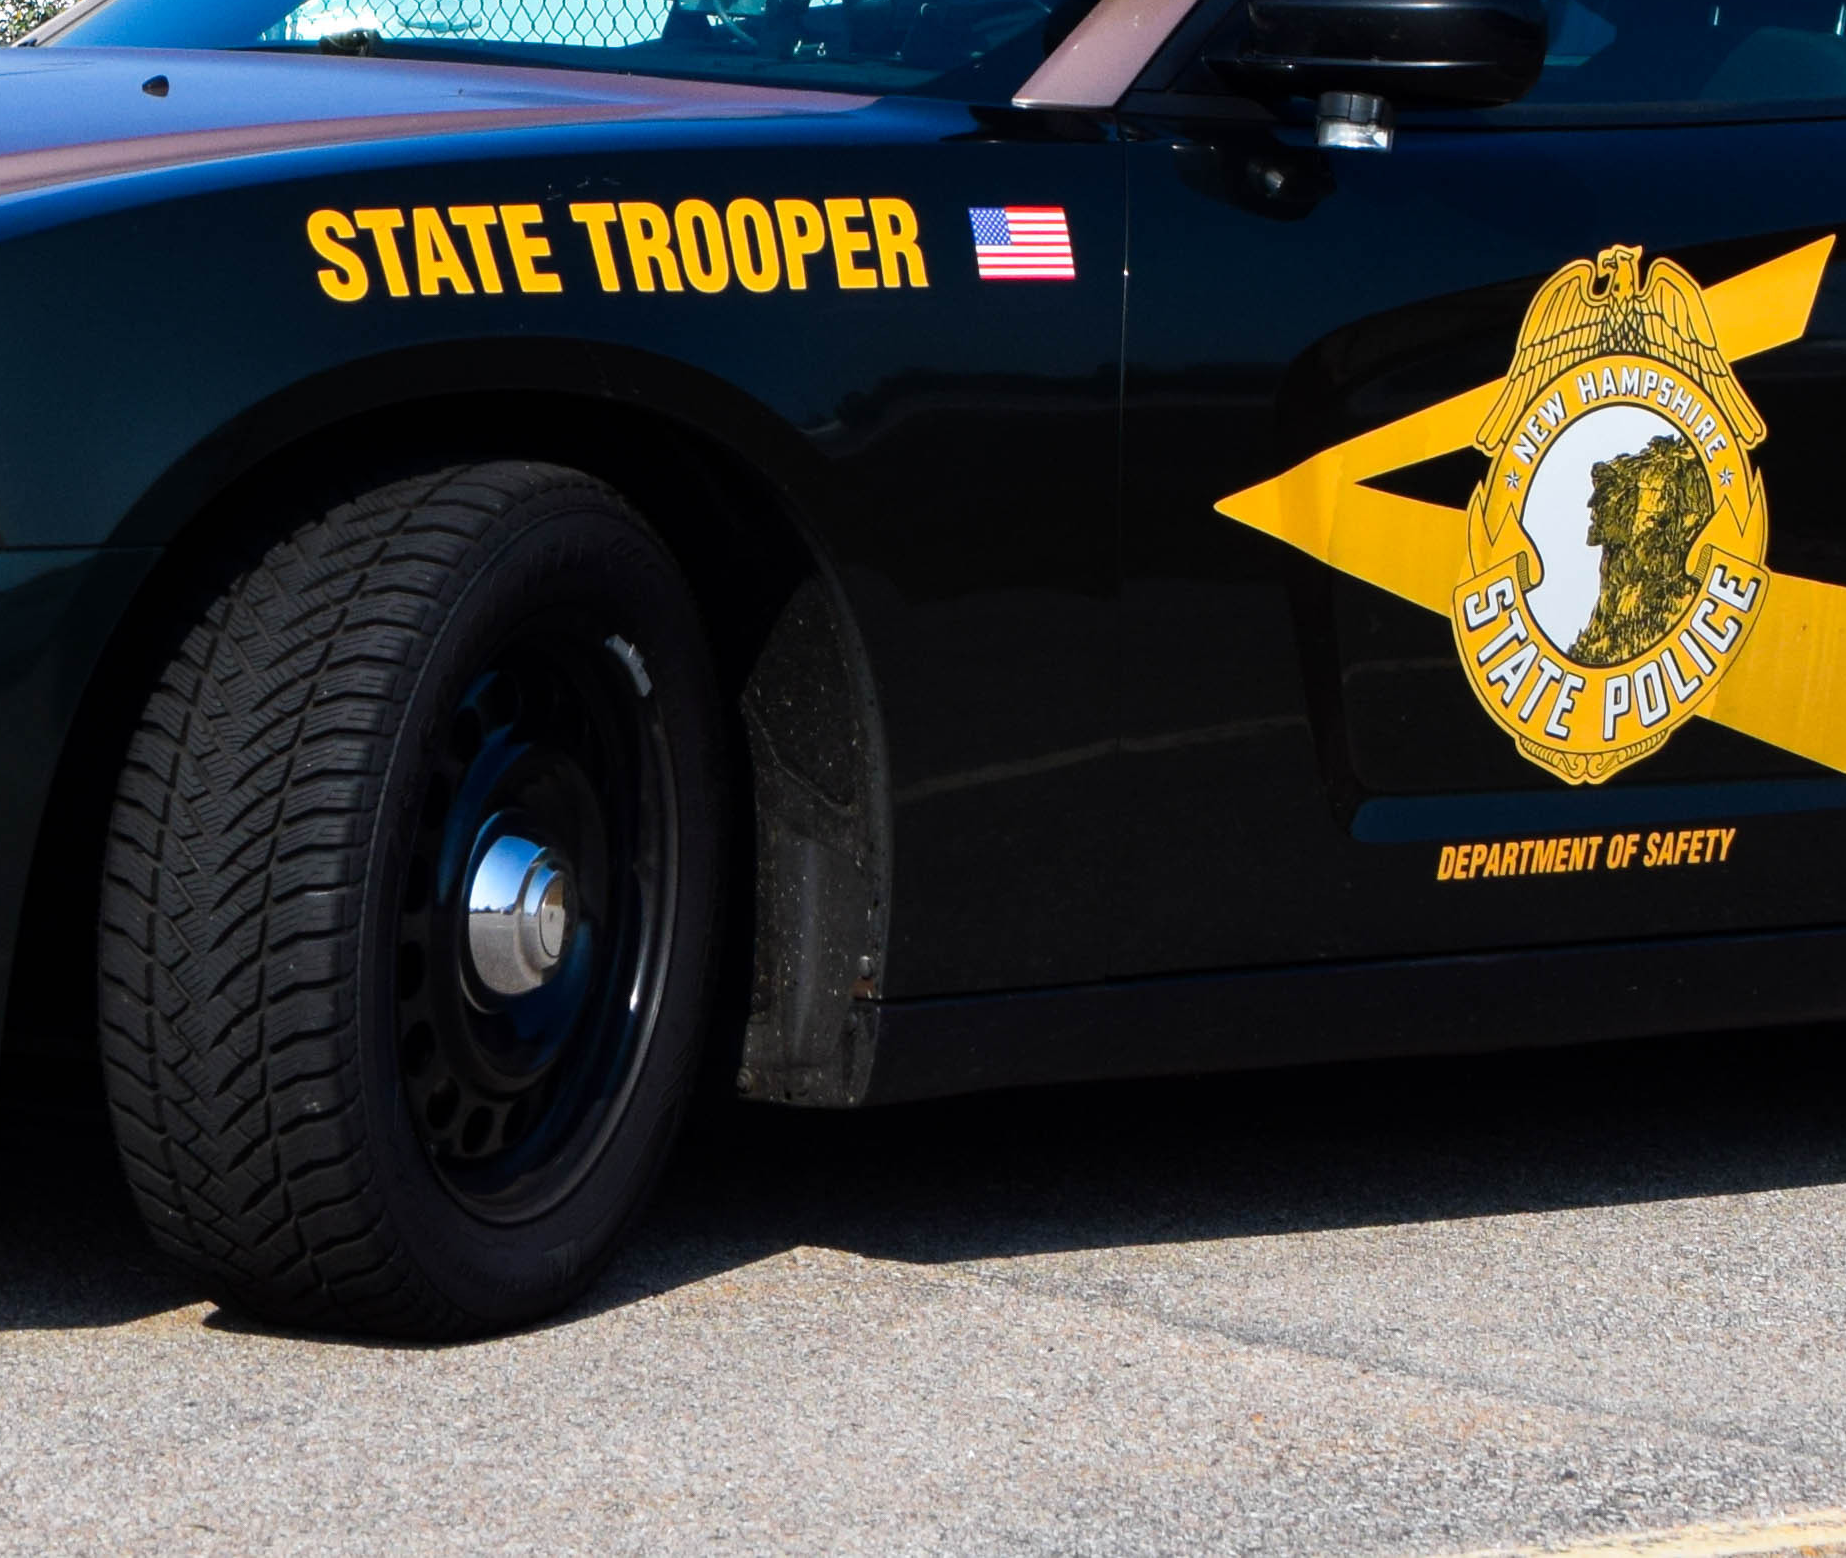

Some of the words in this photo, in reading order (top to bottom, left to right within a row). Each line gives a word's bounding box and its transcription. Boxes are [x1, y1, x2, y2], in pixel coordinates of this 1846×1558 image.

[306, 203, 562, 302] STATE
[569, 197, 929, 293] TROOPER
[1512, 391, 1568, 465] NEW
[1576, 366, 1728, 462] HAMPSHIRE
[1463, 576, 1587, 741] STATE
[1603, 563, 1762, 742] POLICE
[1437, 836, 1602, 881] DEPARTMENT
[1606, 833, 1640, 870] OF
[1643, 828, 1736, 868] SAFETY
